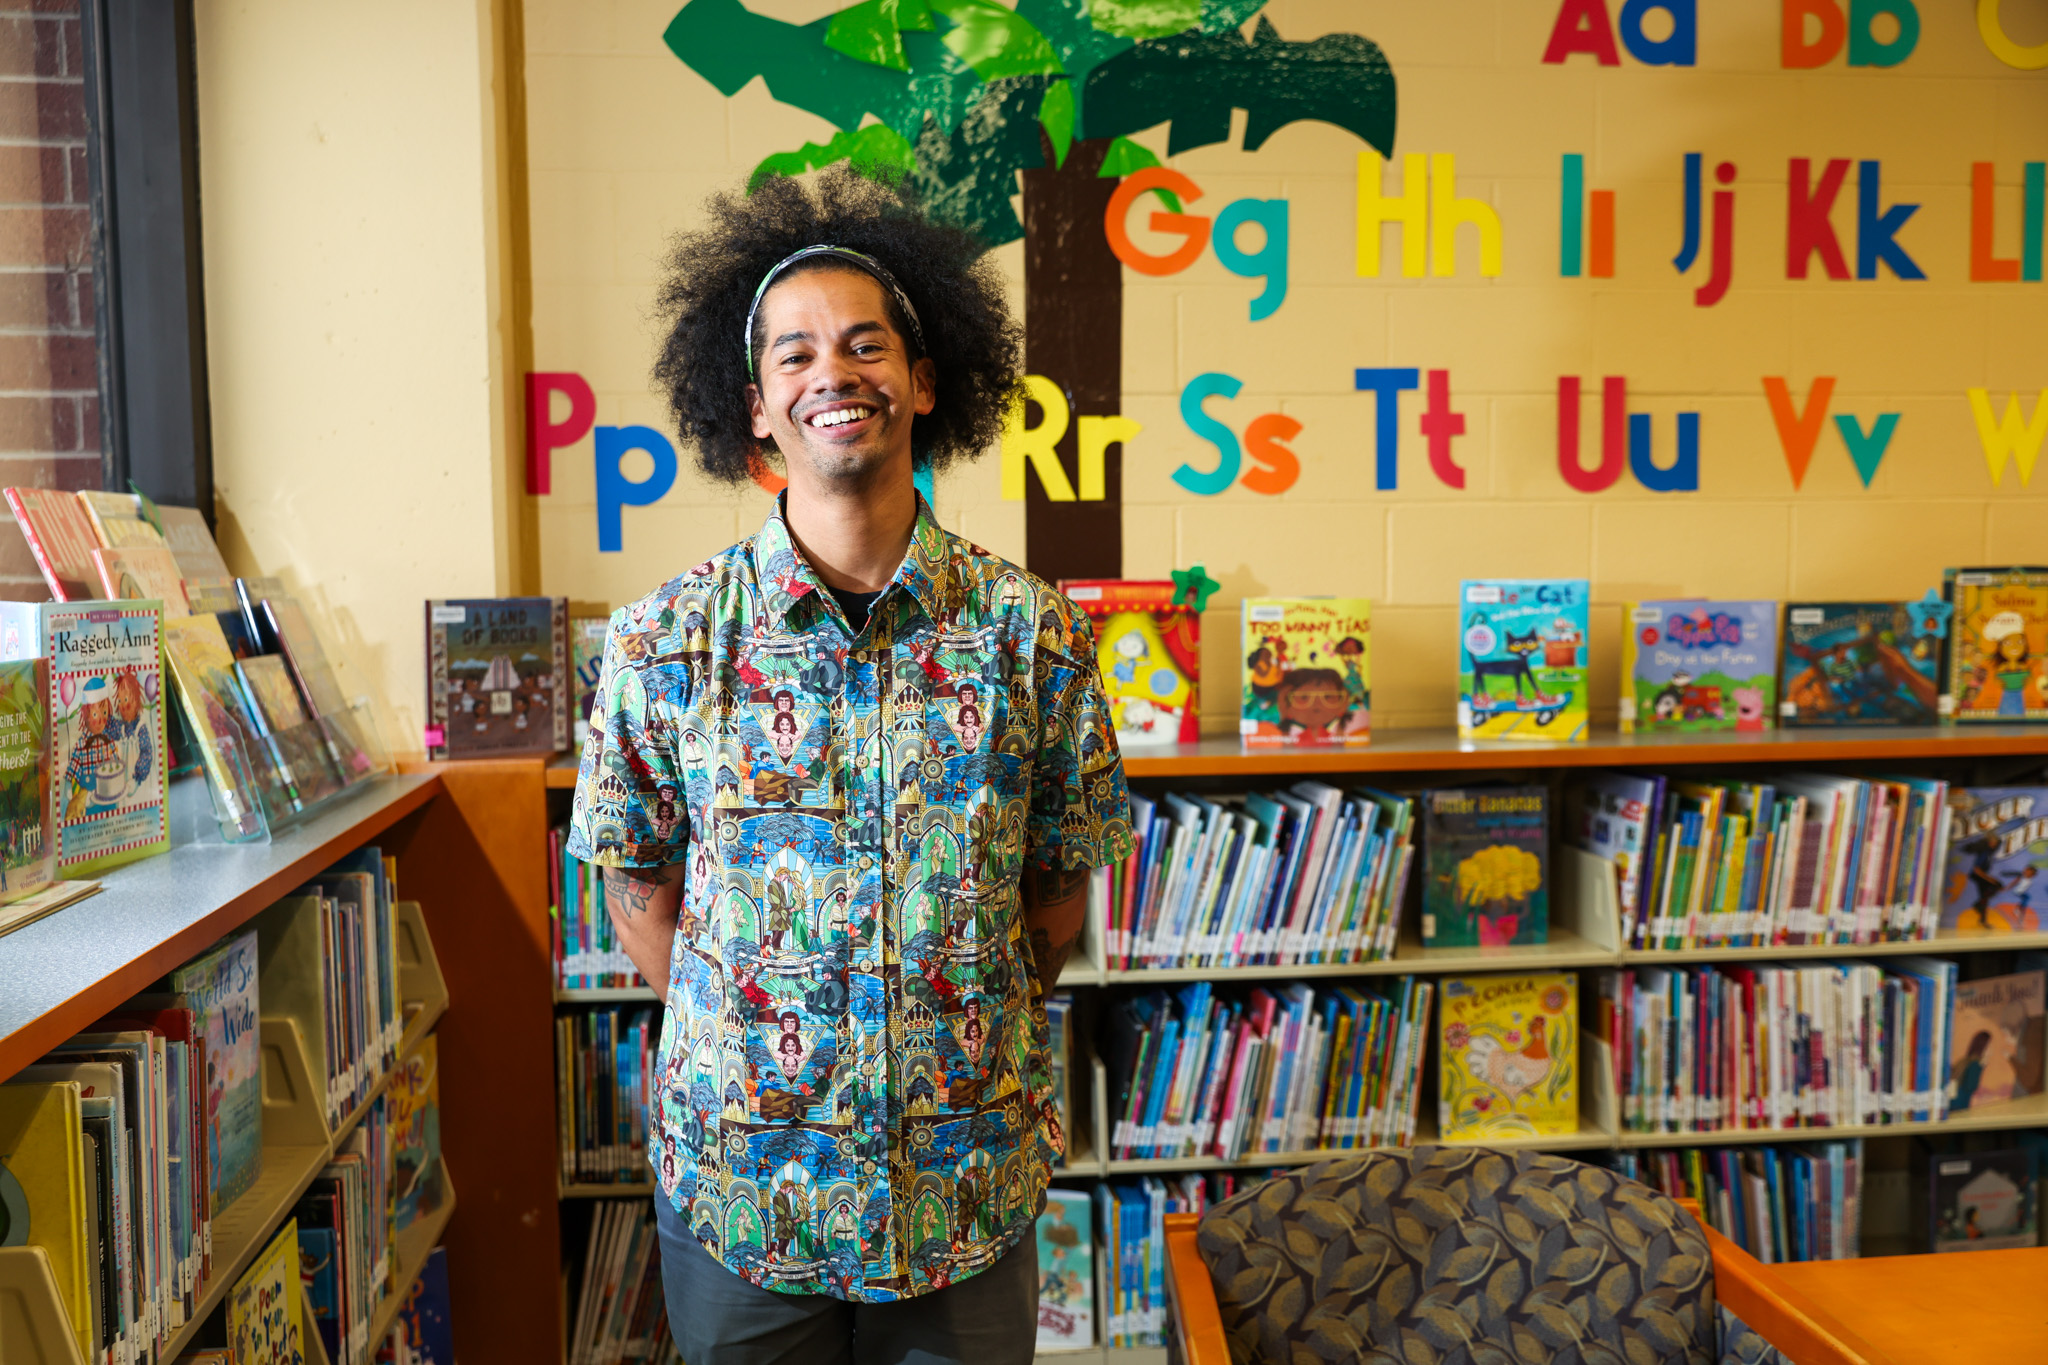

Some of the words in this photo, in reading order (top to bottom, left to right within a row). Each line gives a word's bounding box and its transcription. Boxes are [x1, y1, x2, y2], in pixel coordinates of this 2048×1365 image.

[1104, 166, 1290, 322] Gg
[1355, 150, 1503, 279] Hh
[1671, 152, 1737, 308] Jj
[1785, 157, 1929, 281] Kk
[525, 372, 678, 551] Pp
[1001, 374, 1144, 502] Rr
[1170, 372, 1305, 496] Ss
[1354, 367, 1466, 491] Tt
[1556, 375, 1701, 493] Uu
[1760, 376, 1902, 493] Vv
[488, 609, 528, 626] LAND
[59, 624, 119, 658] Raggedy
[120, 625, 151, 648] Ann
[462, 629, 484, 645] OF
[490, 626, 538, 645] BOOKS
[0, 713, 14, 728] GIVE
[15, 711, 27, 726] THE
[11, 732, 19, 746] TO
[20, 730, 31, 744] THE
[192, 959, 231, 1016] World
[237, 947, 254, 993] So
[222, 996, 255, 1046] Wide
